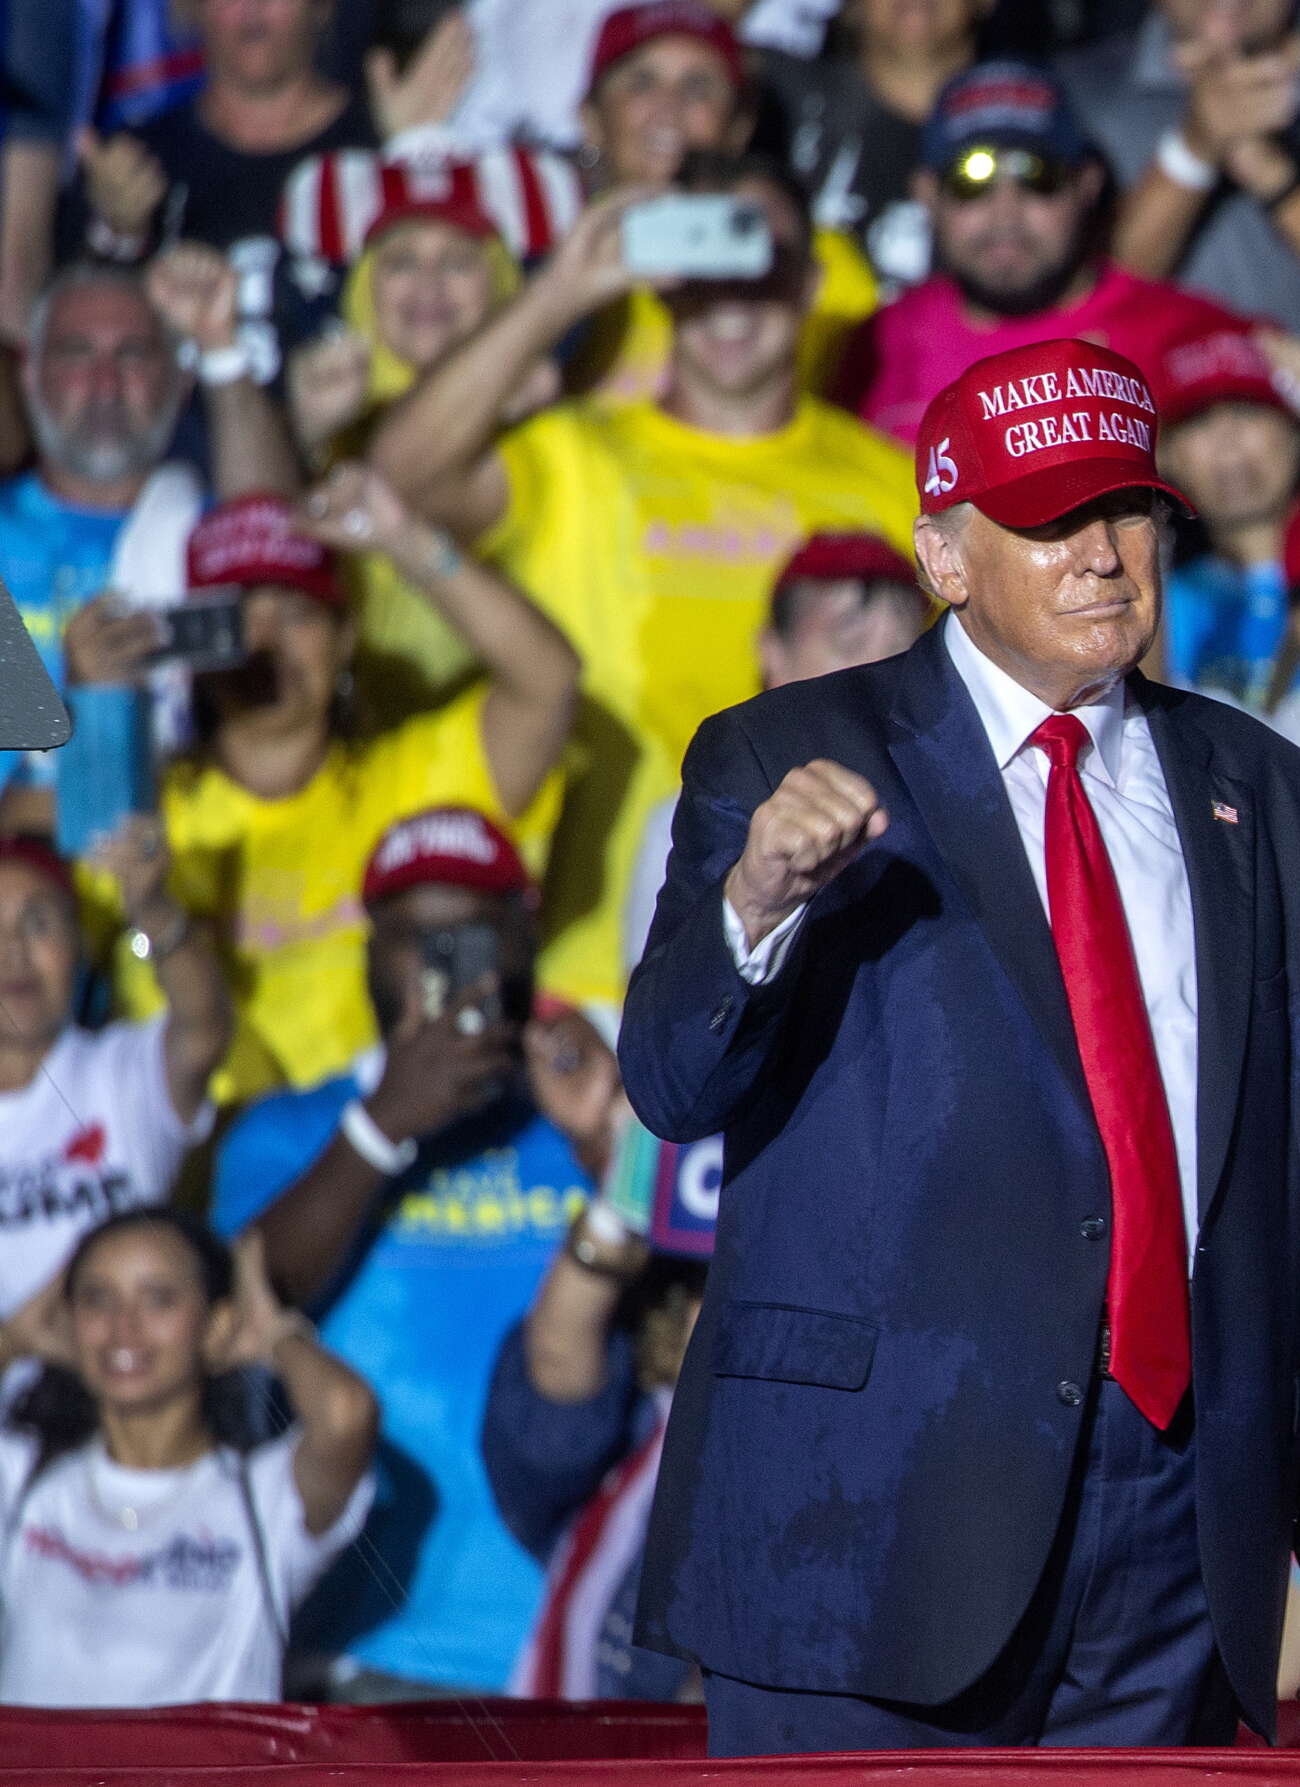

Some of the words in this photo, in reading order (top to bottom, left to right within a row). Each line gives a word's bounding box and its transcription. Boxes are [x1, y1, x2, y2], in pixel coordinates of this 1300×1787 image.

[978, 372, 1062, 421] MAKE
[1065, 367, 1156, 415] AMERICA
[1004, 411, 1093, 458] GREAT
[1098, 411, 1151, 452] AGAIN
[924, 437, 959, 497] 45
